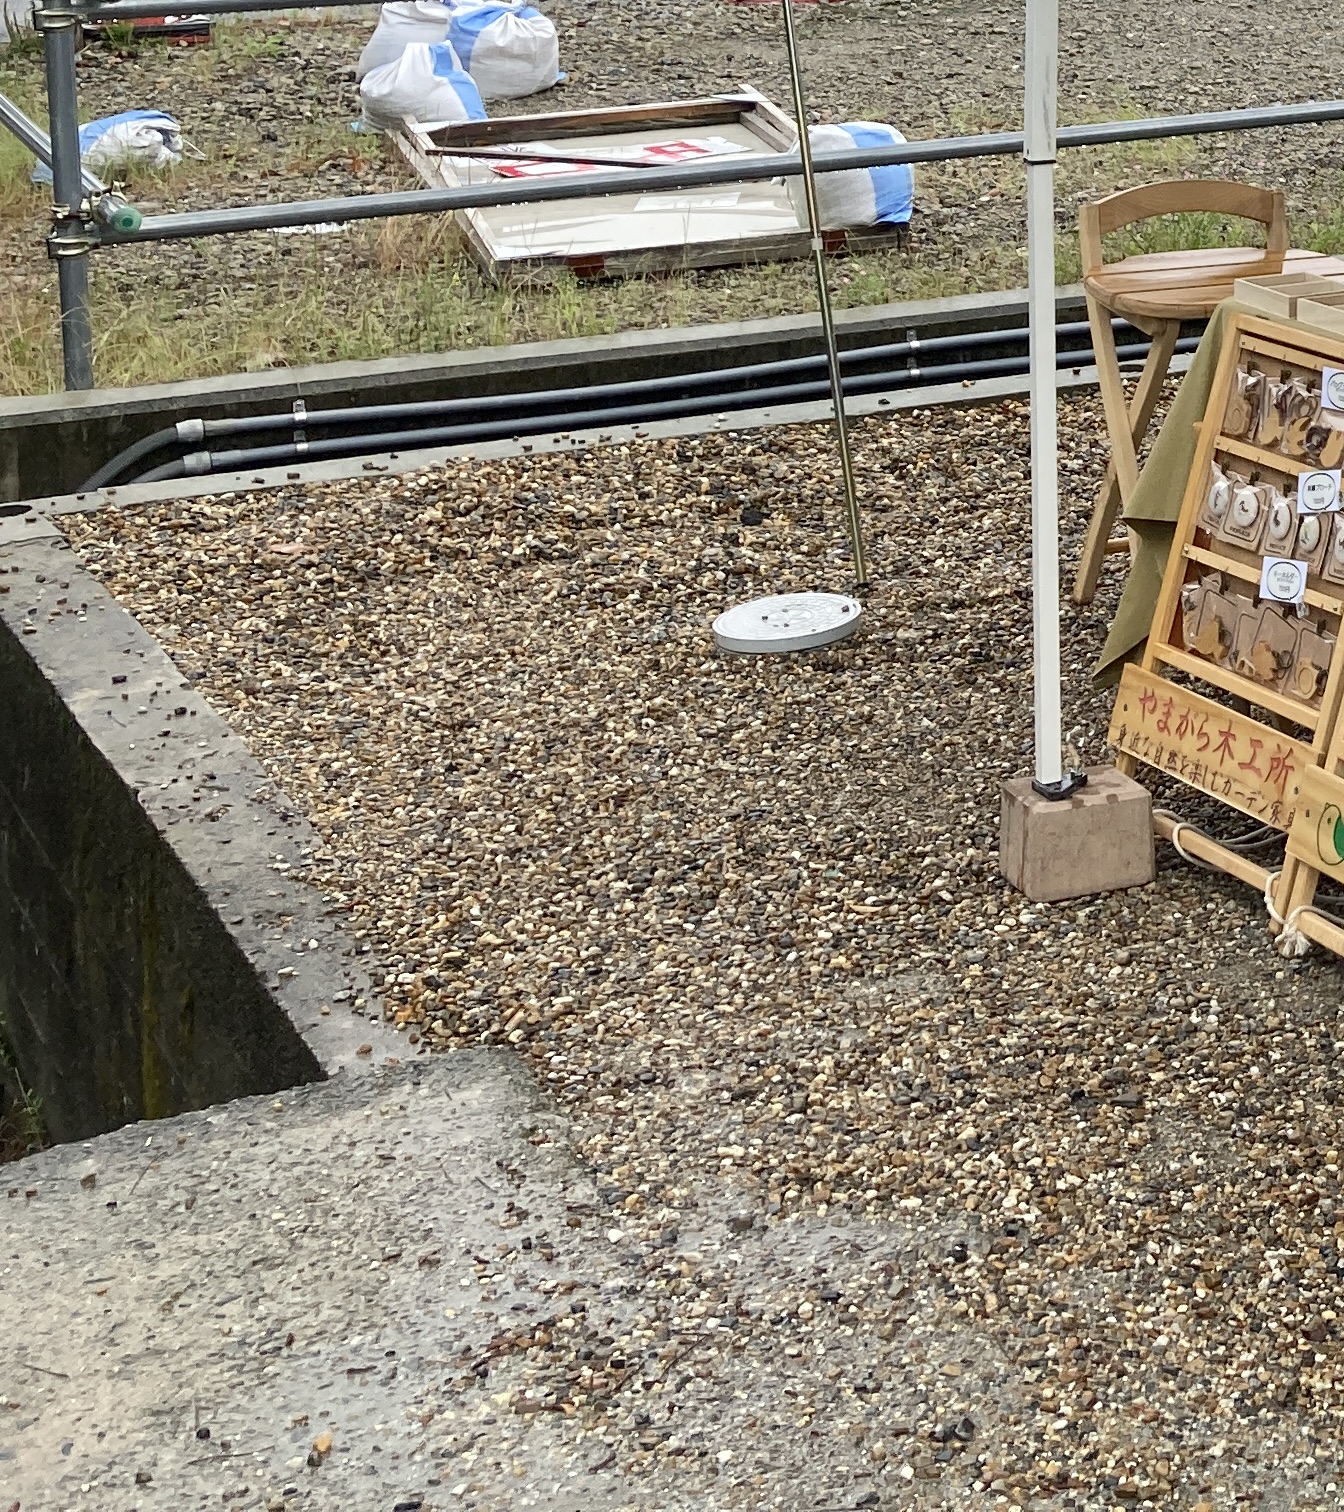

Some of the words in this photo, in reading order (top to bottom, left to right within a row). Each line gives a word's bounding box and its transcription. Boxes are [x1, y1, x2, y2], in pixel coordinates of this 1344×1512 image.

[1138, 686, 1296, 799] やまがら木工所
